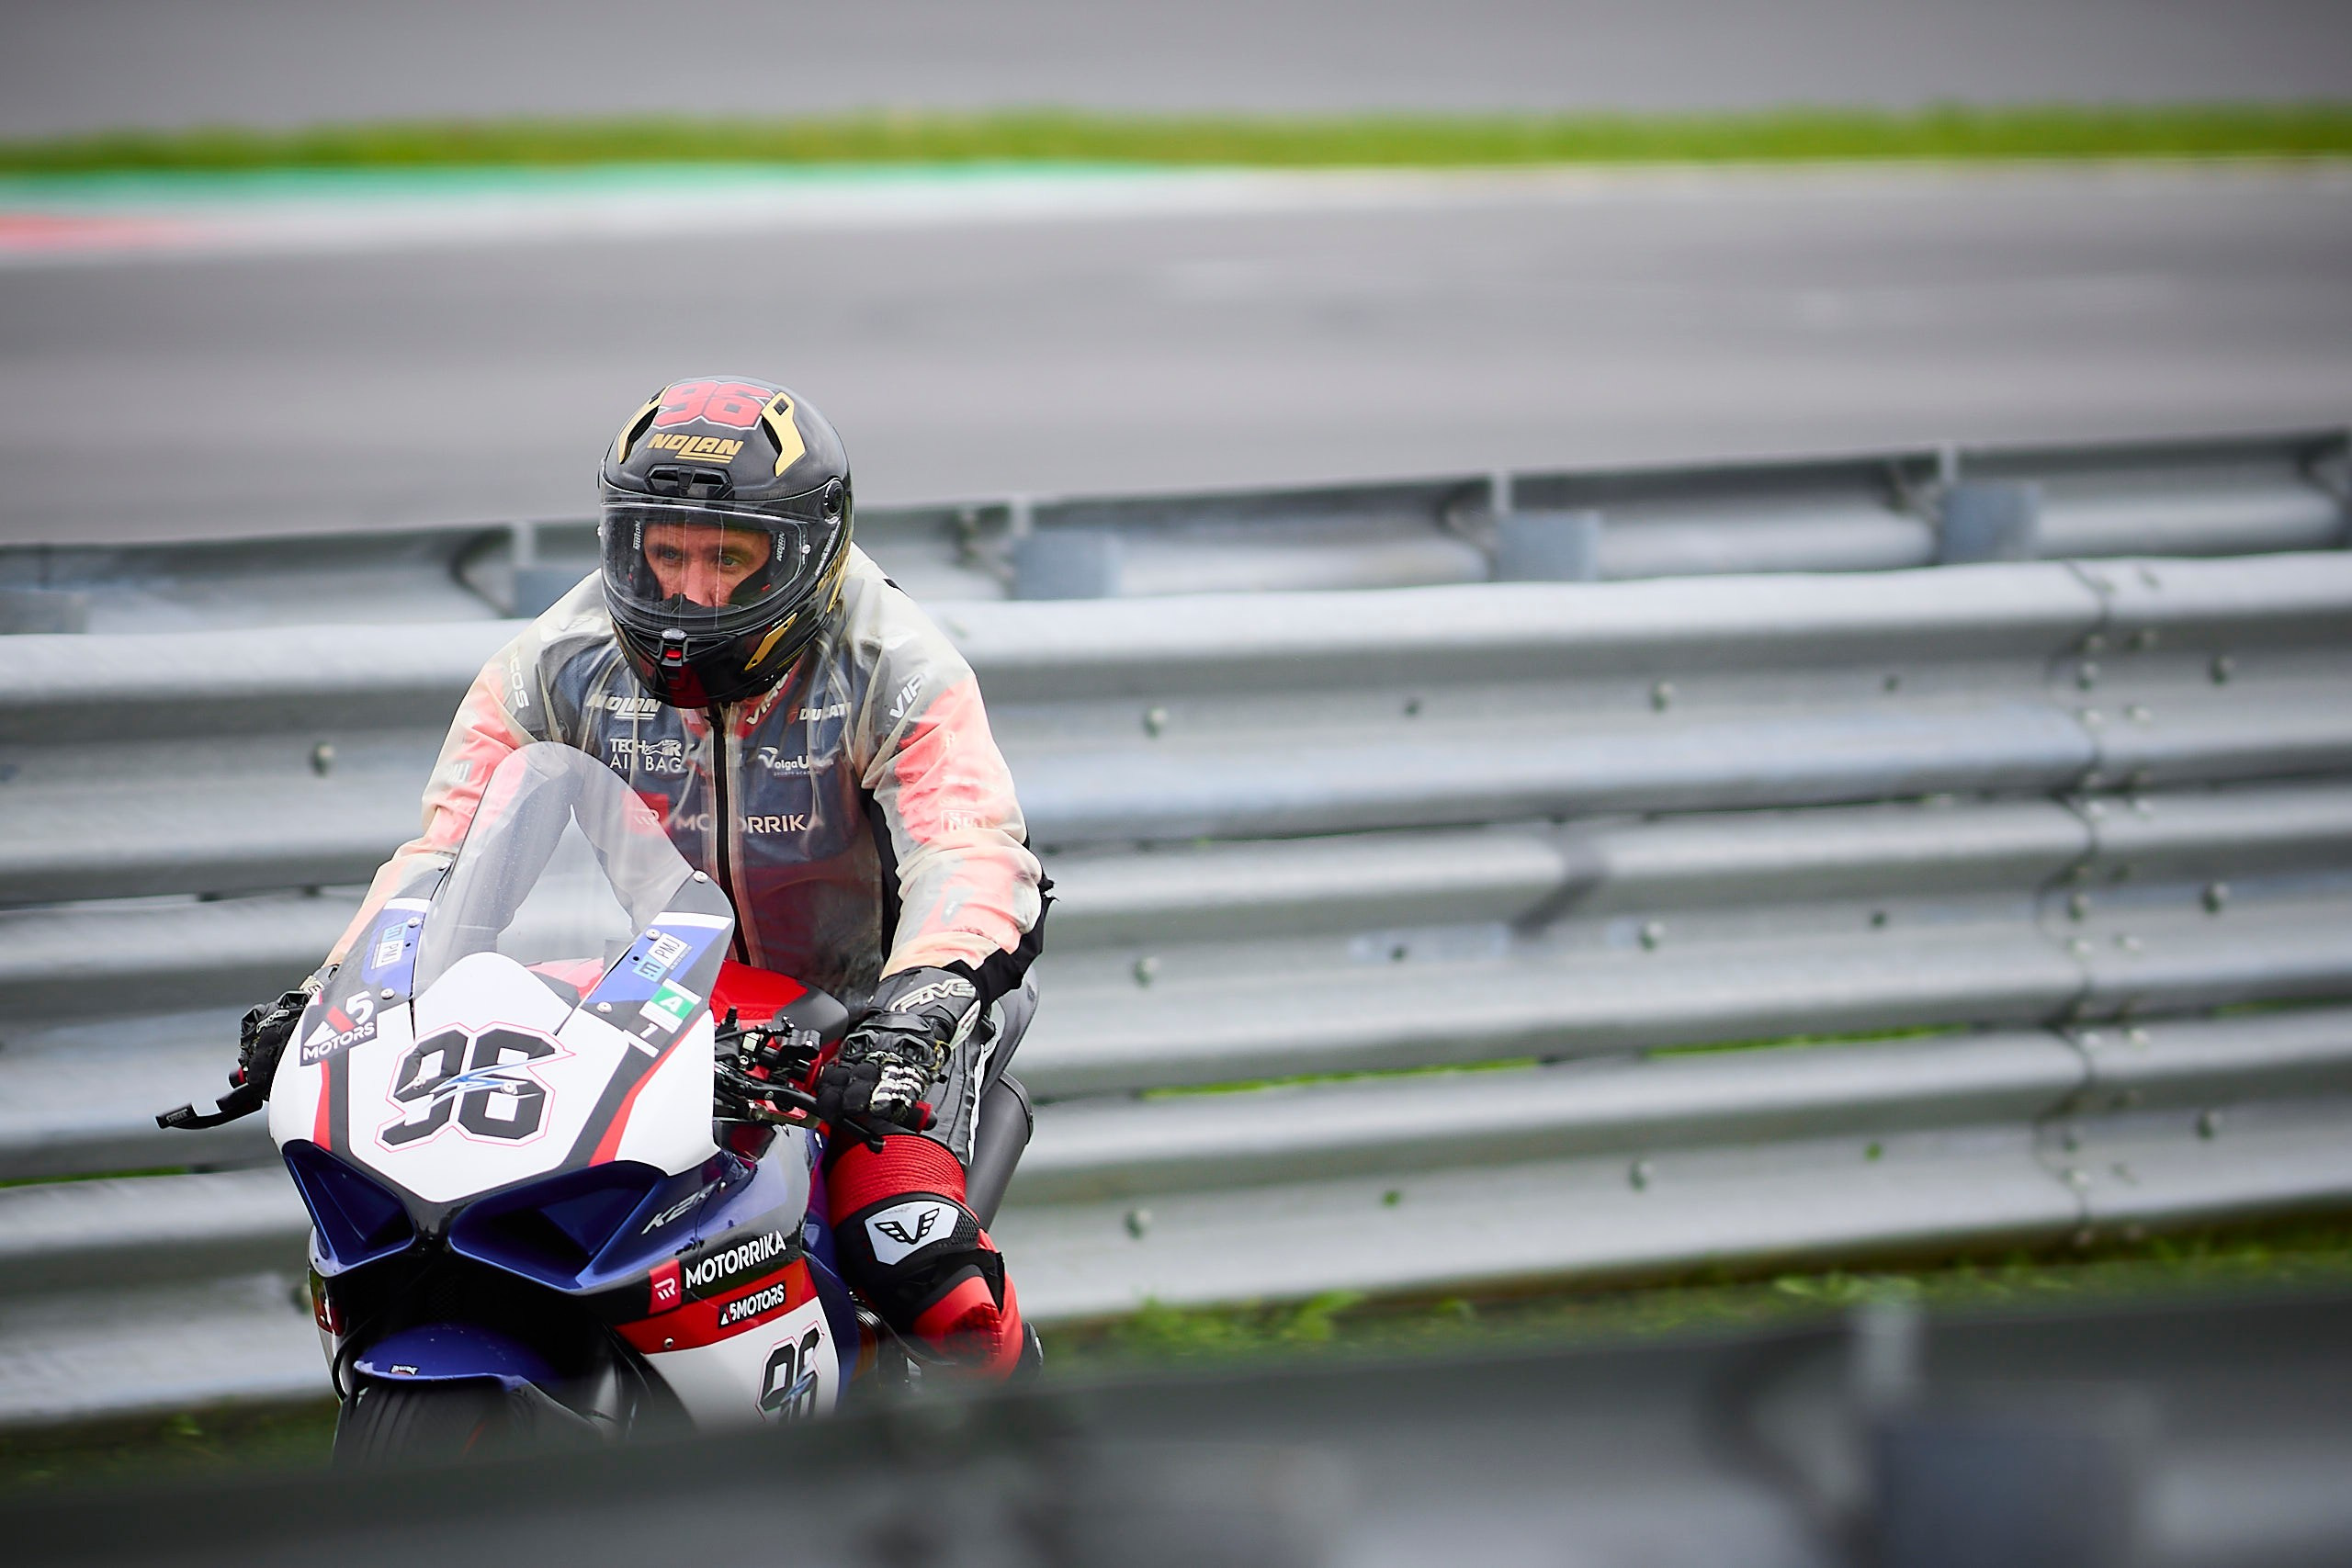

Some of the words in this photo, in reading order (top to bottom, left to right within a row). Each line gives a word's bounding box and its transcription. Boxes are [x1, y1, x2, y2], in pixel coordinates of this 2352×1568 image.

[653, 380, 775, 429] 96
[647, 433, 744, 464] NOLAN
[654, 937, 681, 960] PMJ
[301, 1021, 376, 1061] MOTORS
[381, 1028, 555, 1146] 96
[684, 1229, 787, 1290] MOTORRIKA
